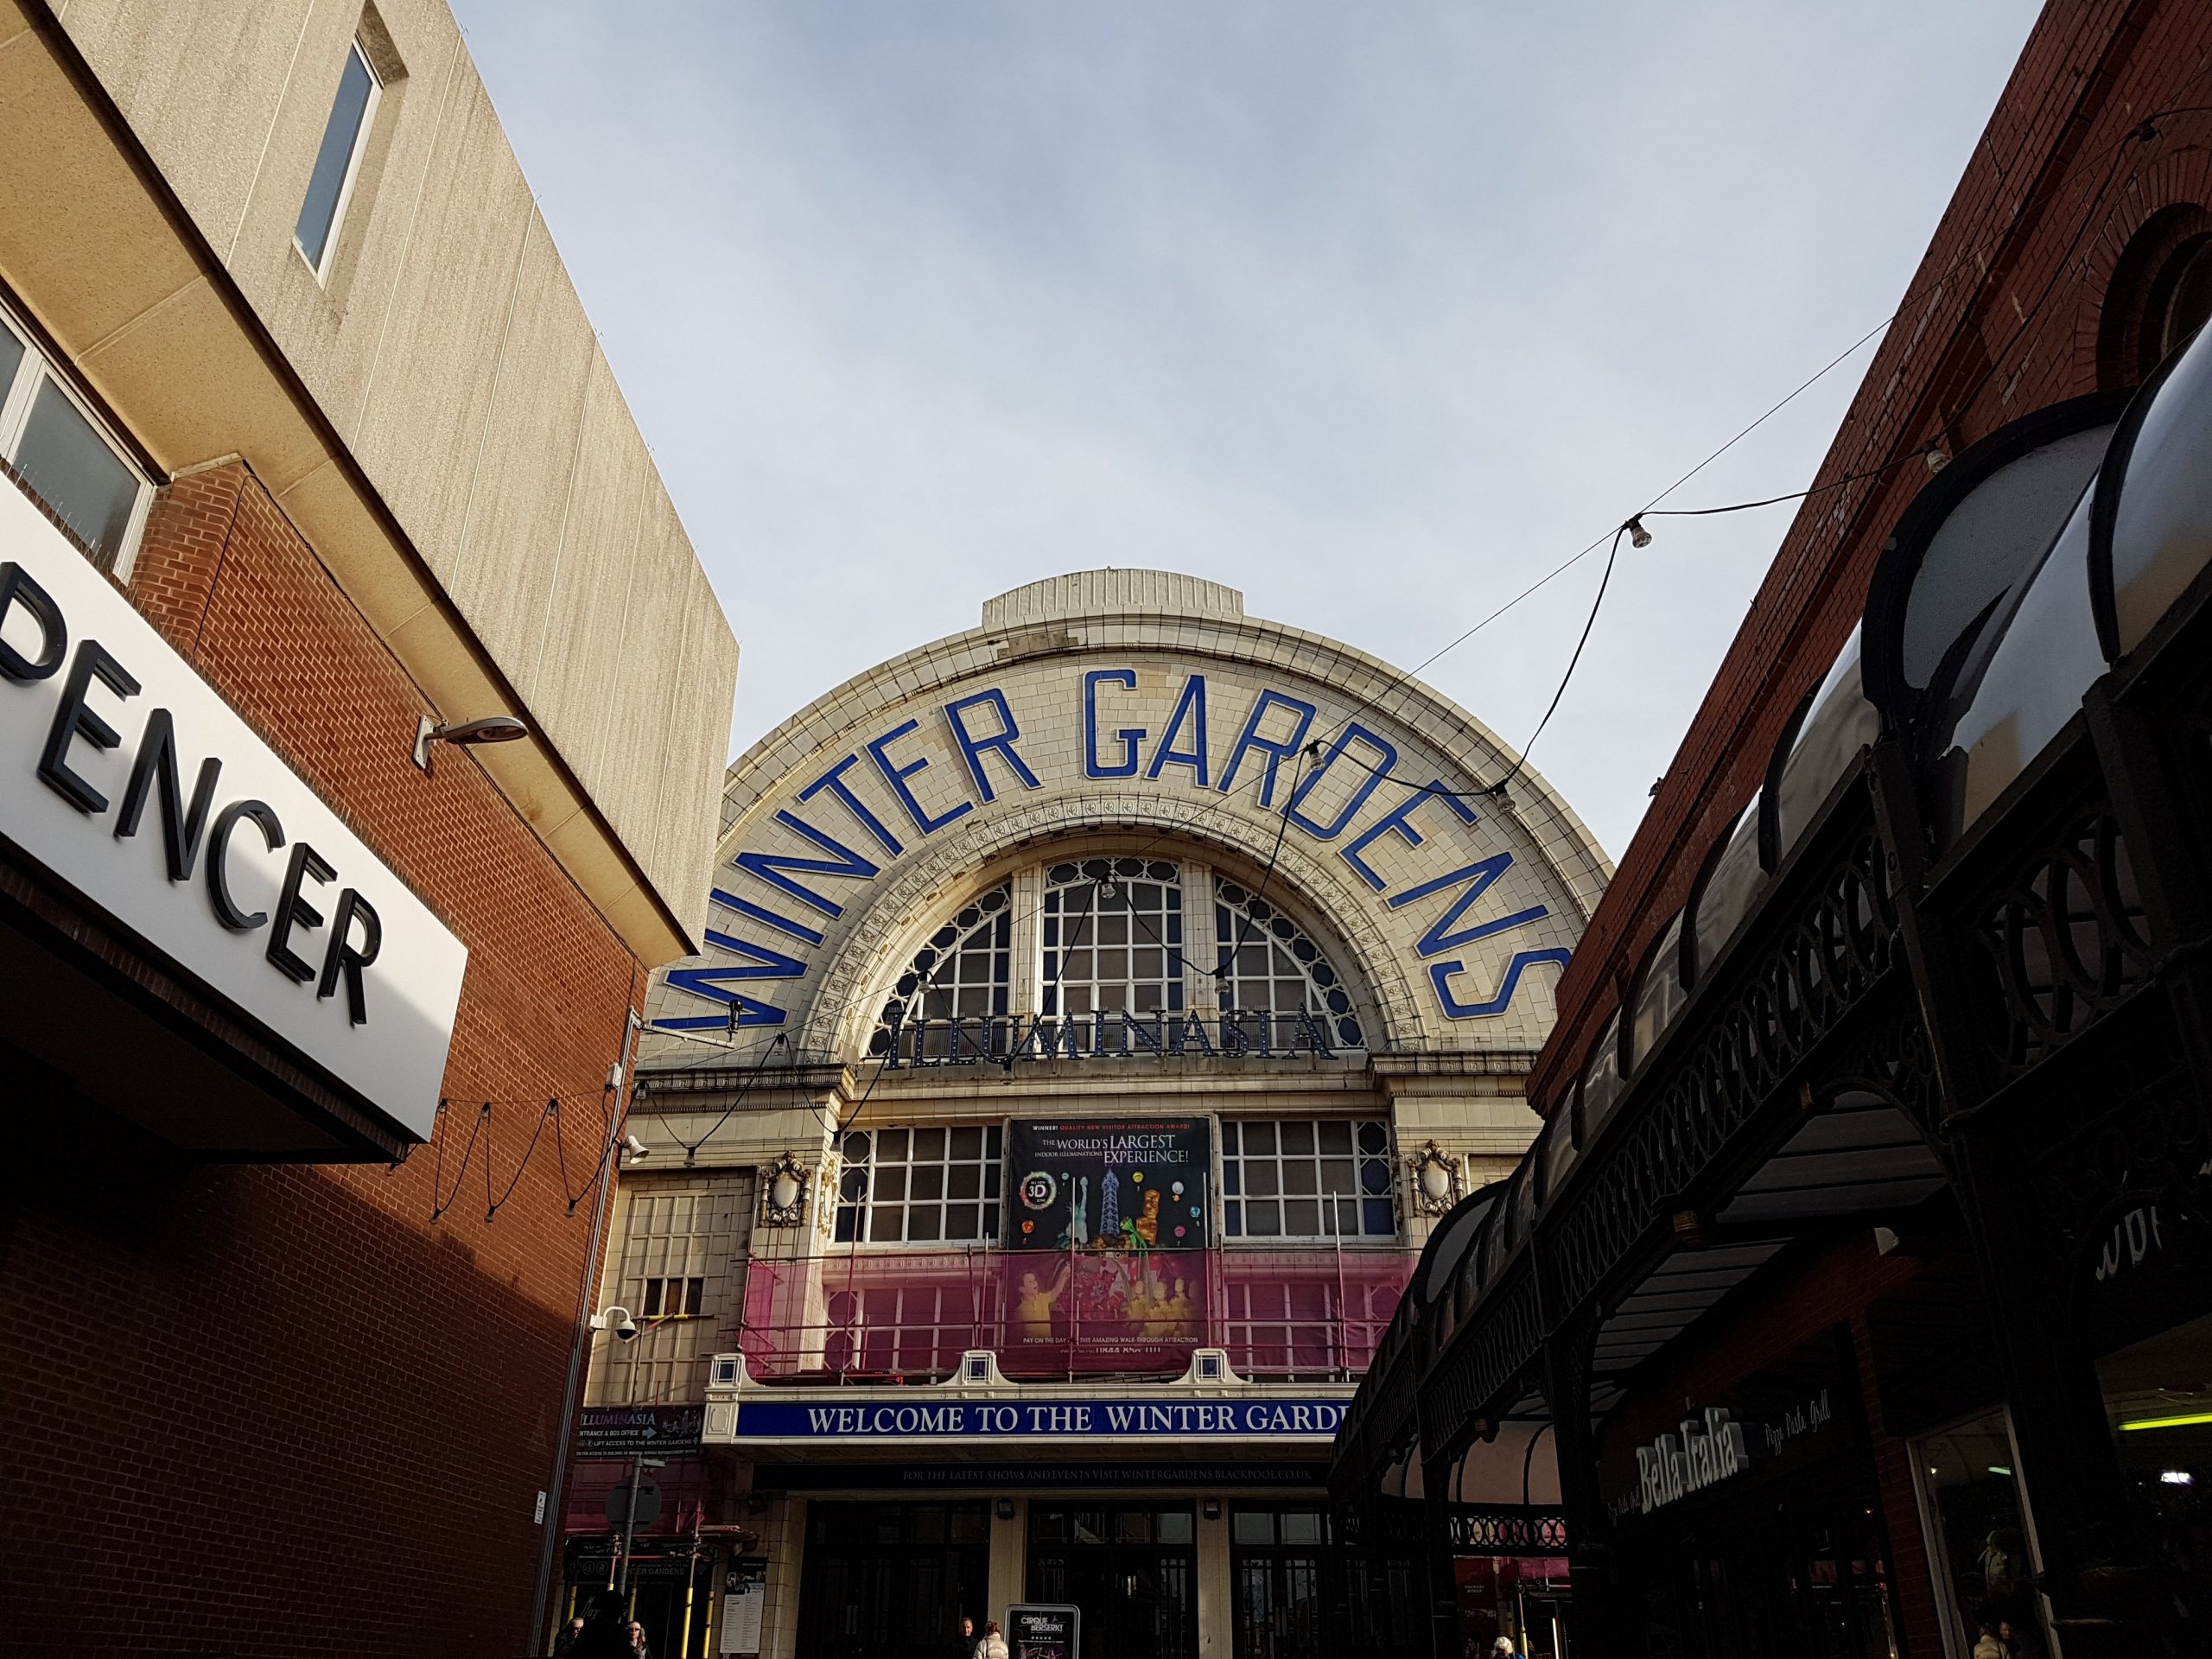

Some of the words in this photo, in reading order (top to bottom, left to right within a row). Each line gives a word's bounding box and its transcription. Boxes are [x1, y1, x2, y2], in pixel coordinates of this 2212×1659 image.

[651, 688, 1042, 1029] WINTER
[1083, 668, 1572, 1020] GARDENS
[886, 1001, 1339, 1070] ILLUMINASIA
[1057, 1138, 1108, 1149] WORLD'S
[1109, 1135, 1175, 1149] LARGEST
[1104, 1150, 1189, 1164] EXPERIENCE!
[1027, 1184, 1046, 1198] 3D
[580, 1411, 656, 1426] ILLUMINASIA
[808, 1407, 964, 1433] WELCOME
[975, 1407, 1019, 1433] TO
[1027, 1407, 1092, 1432] THE
[1105, 1405, 1238, 1432] WINTER
[1784, 1403, 1807, 1439] Pasta
[1810, 1388, 1832, 1433] Grill
[1636, 1433, 1683, 1515] Bella
[1679, 1407, 1740, 1492] Italia
[903, 1471, 925, 1480] FOR
[927, 1471, 948, 1480] THE
[950, 1471, 984, 1480] LATEST
[987, 1471, 1025, 1480] SHOWS
[1026, 1471, 1051, 1480] AND
[1052, 1470, 1090, 1480] EVENTS
[1092, 1470, 1119, 1480] VISIT
